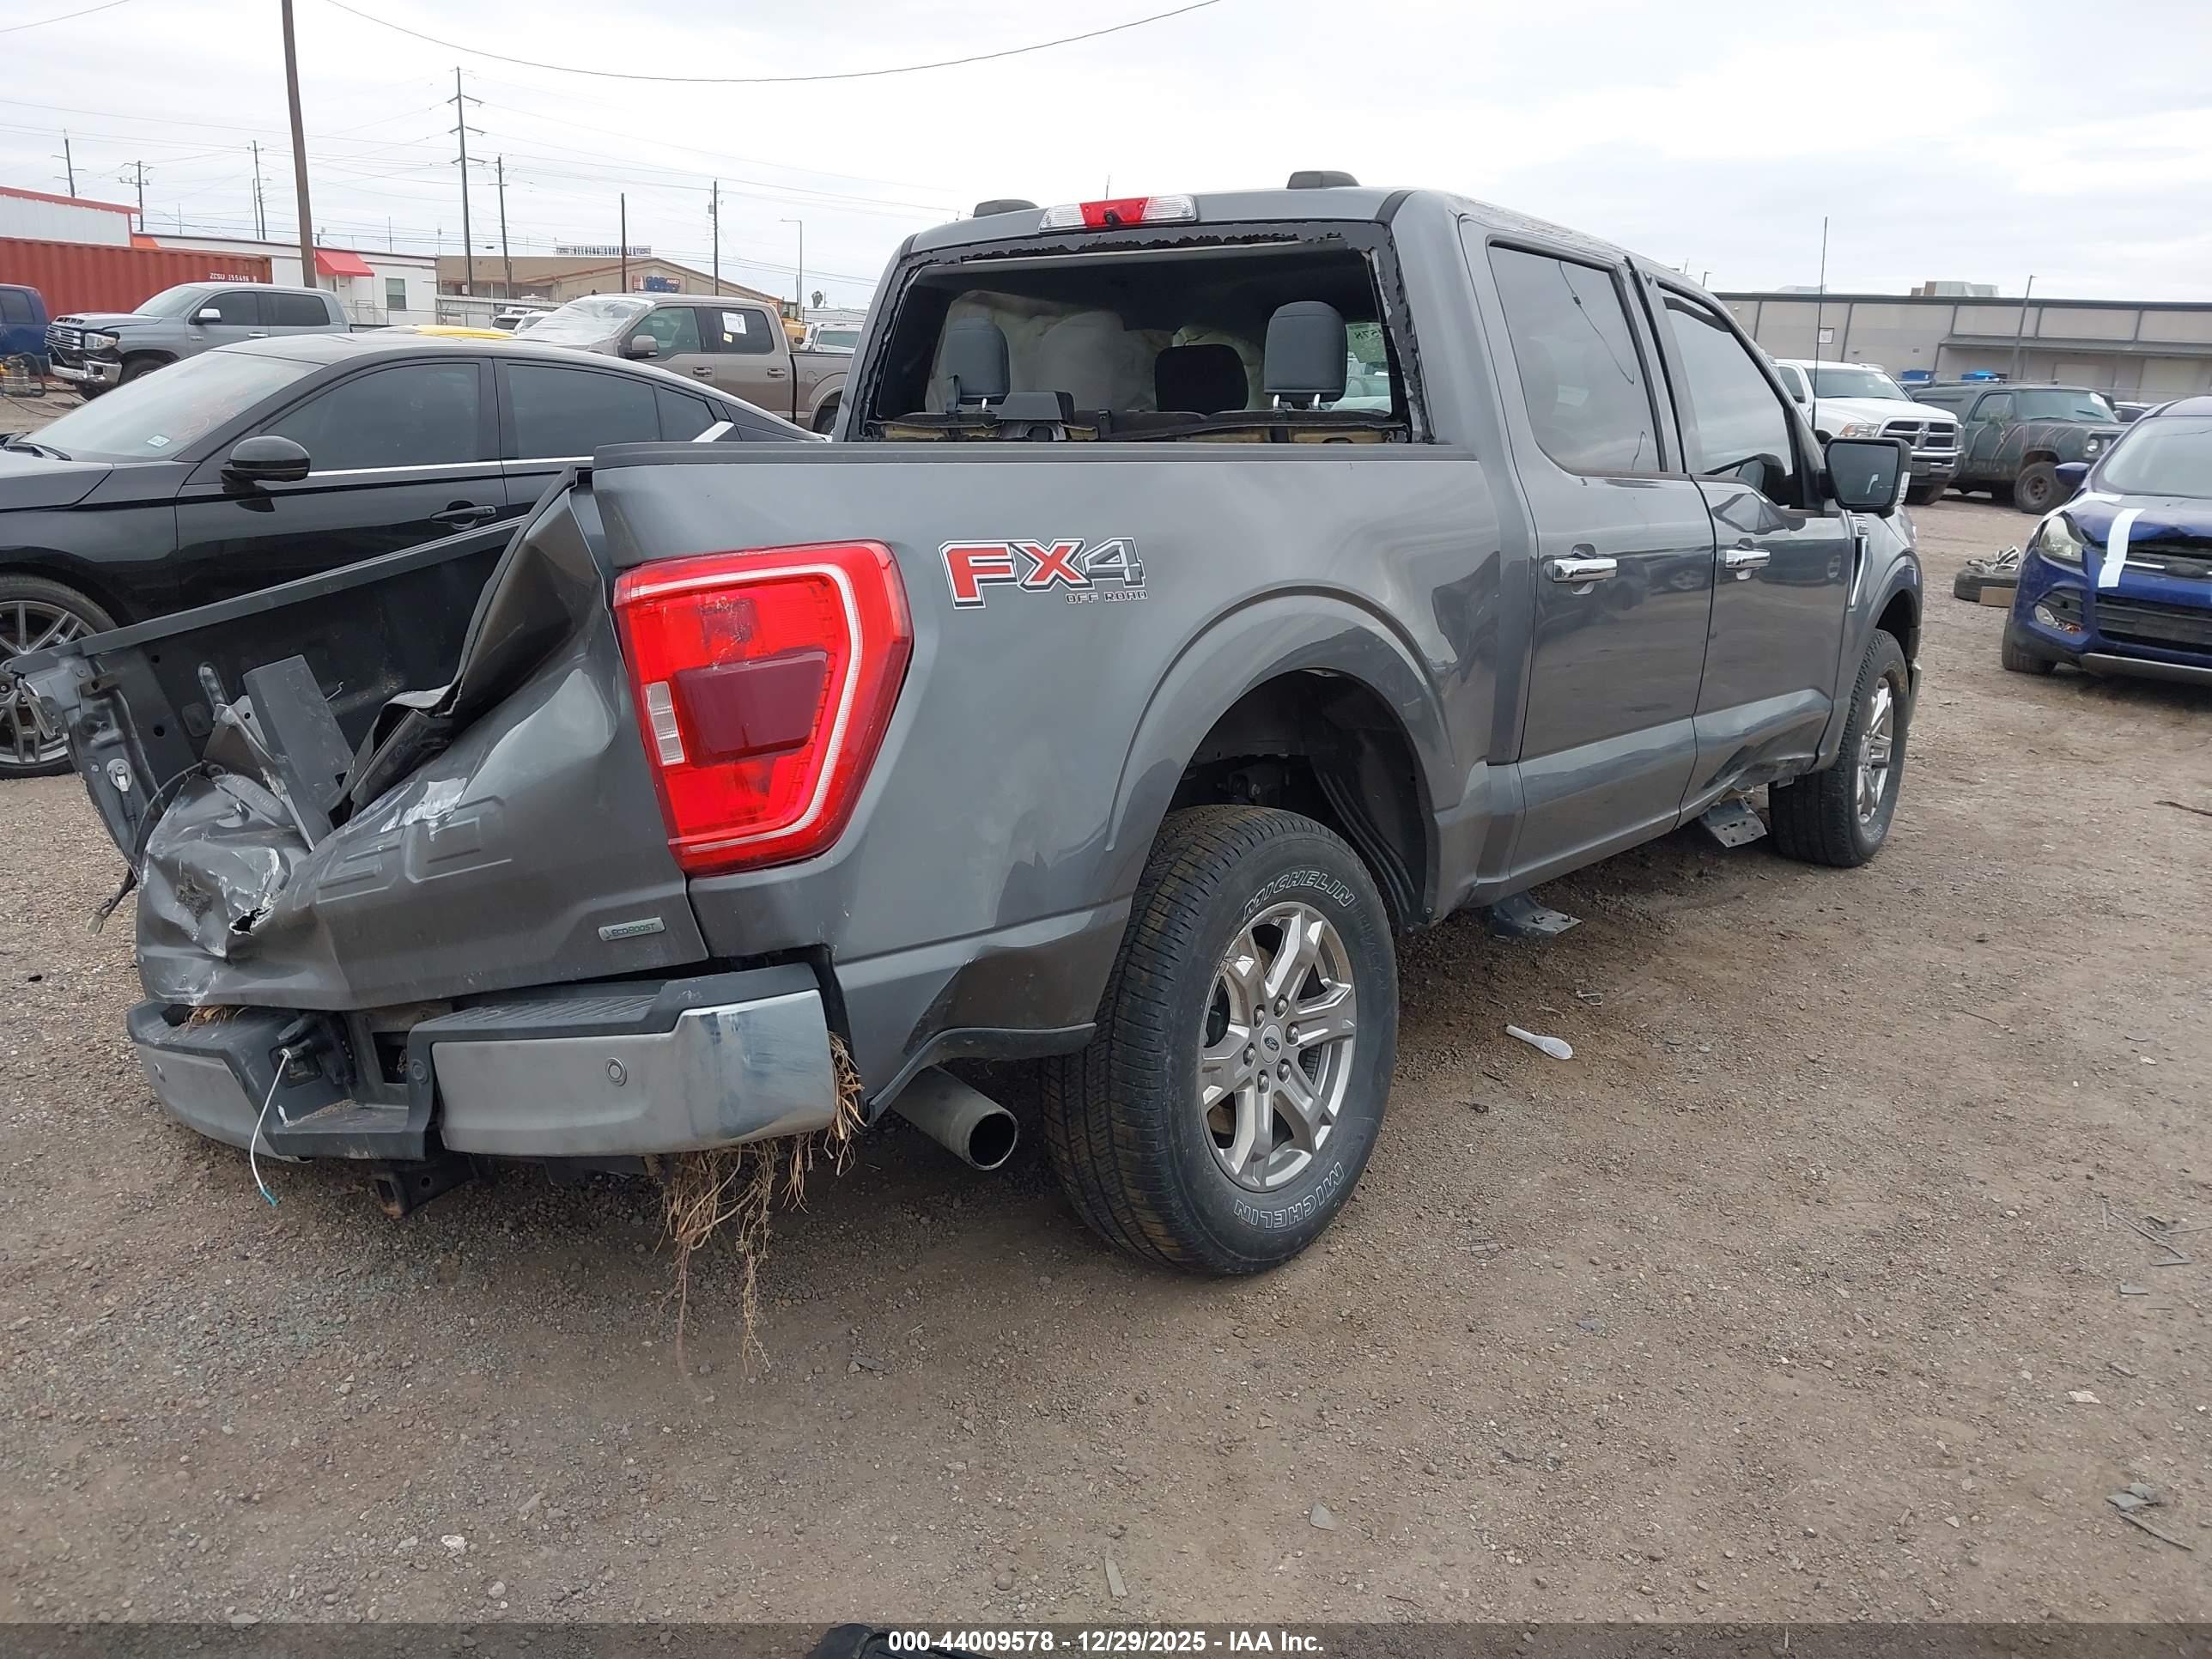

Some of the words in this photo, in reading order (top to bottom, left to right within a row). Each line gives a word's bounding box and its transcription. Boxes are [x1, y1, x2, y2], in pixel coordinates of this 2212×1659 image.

[938, 537, 1146, 610] FX4
[1065, 592, 1099, 604] OFF
[1104, 589, 1148, 603] ROAD
[1243, 871, 1356, 921] MICHELIN
[1233, 1161, 1345, 1229] MICHELIN
